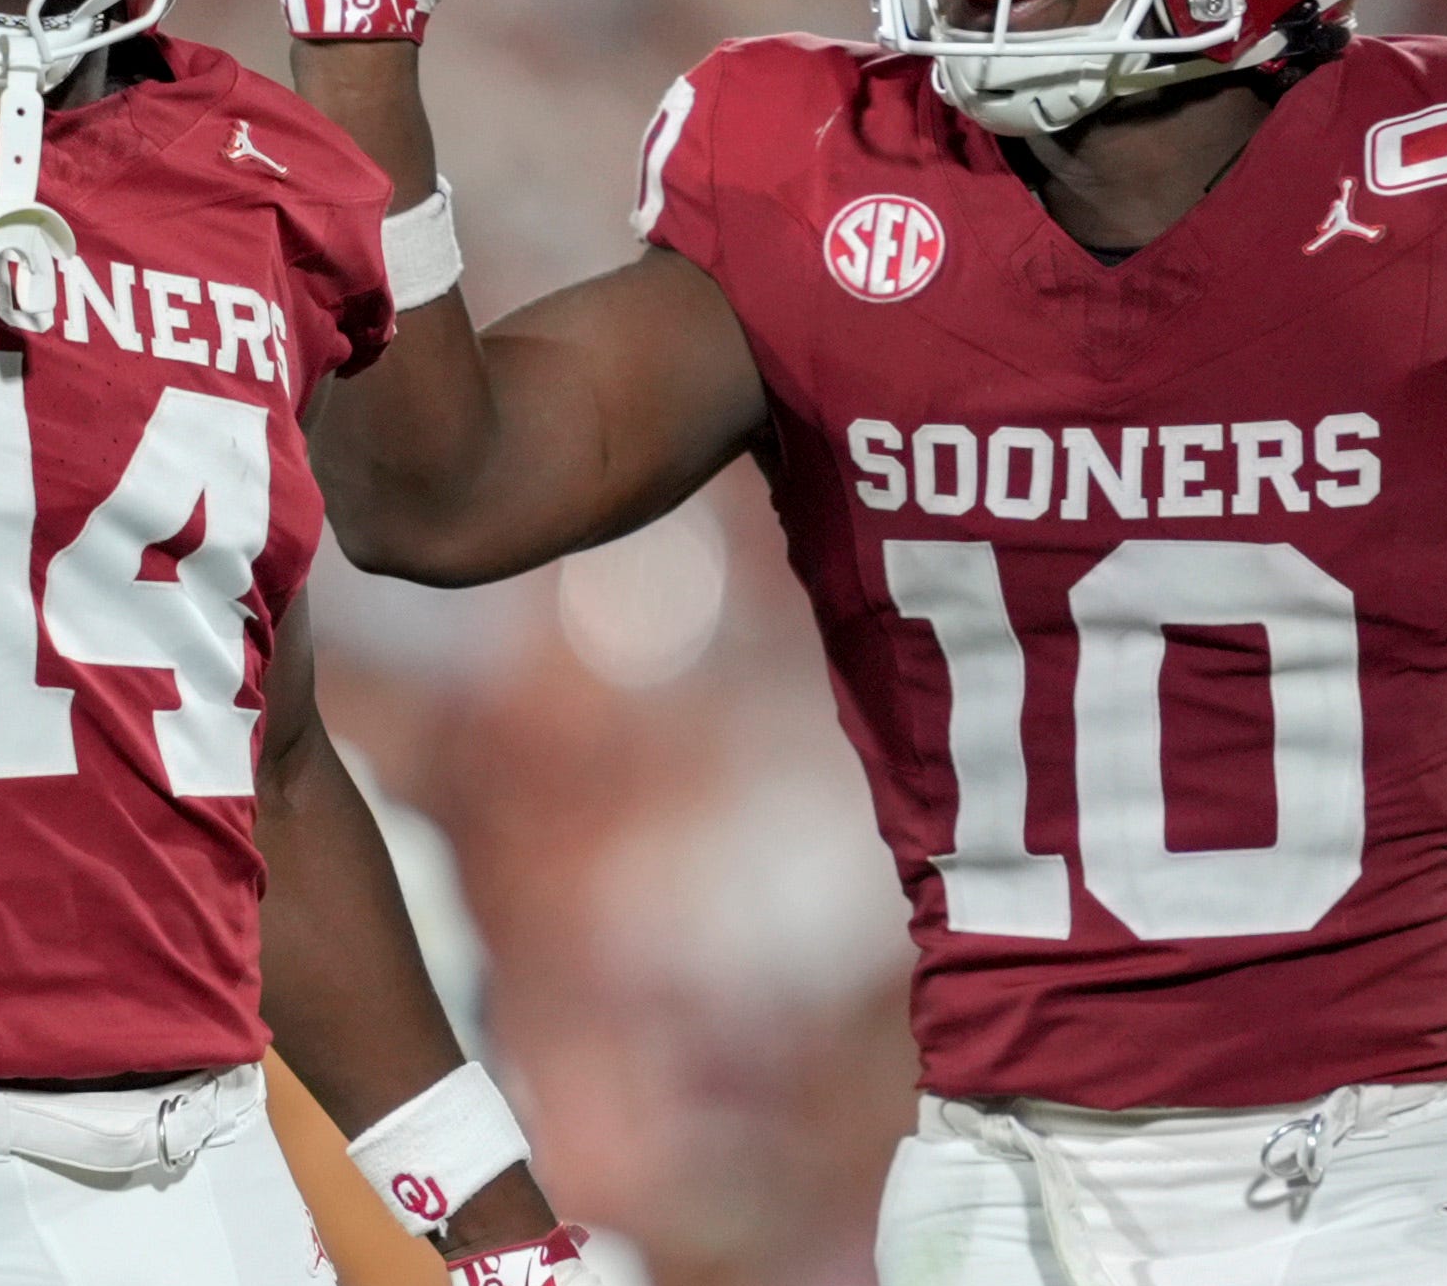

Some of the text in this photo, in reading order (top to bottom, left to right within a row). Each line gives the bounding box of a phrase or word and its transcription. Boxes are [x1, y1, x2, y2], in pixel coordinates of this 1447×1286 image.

[835, 200, 937, 296] SEC
[846, 412, 1382, 521] SOONERS
[882, 539, 1364, 941] 10
[392, 1173, 448, 1222] OU
